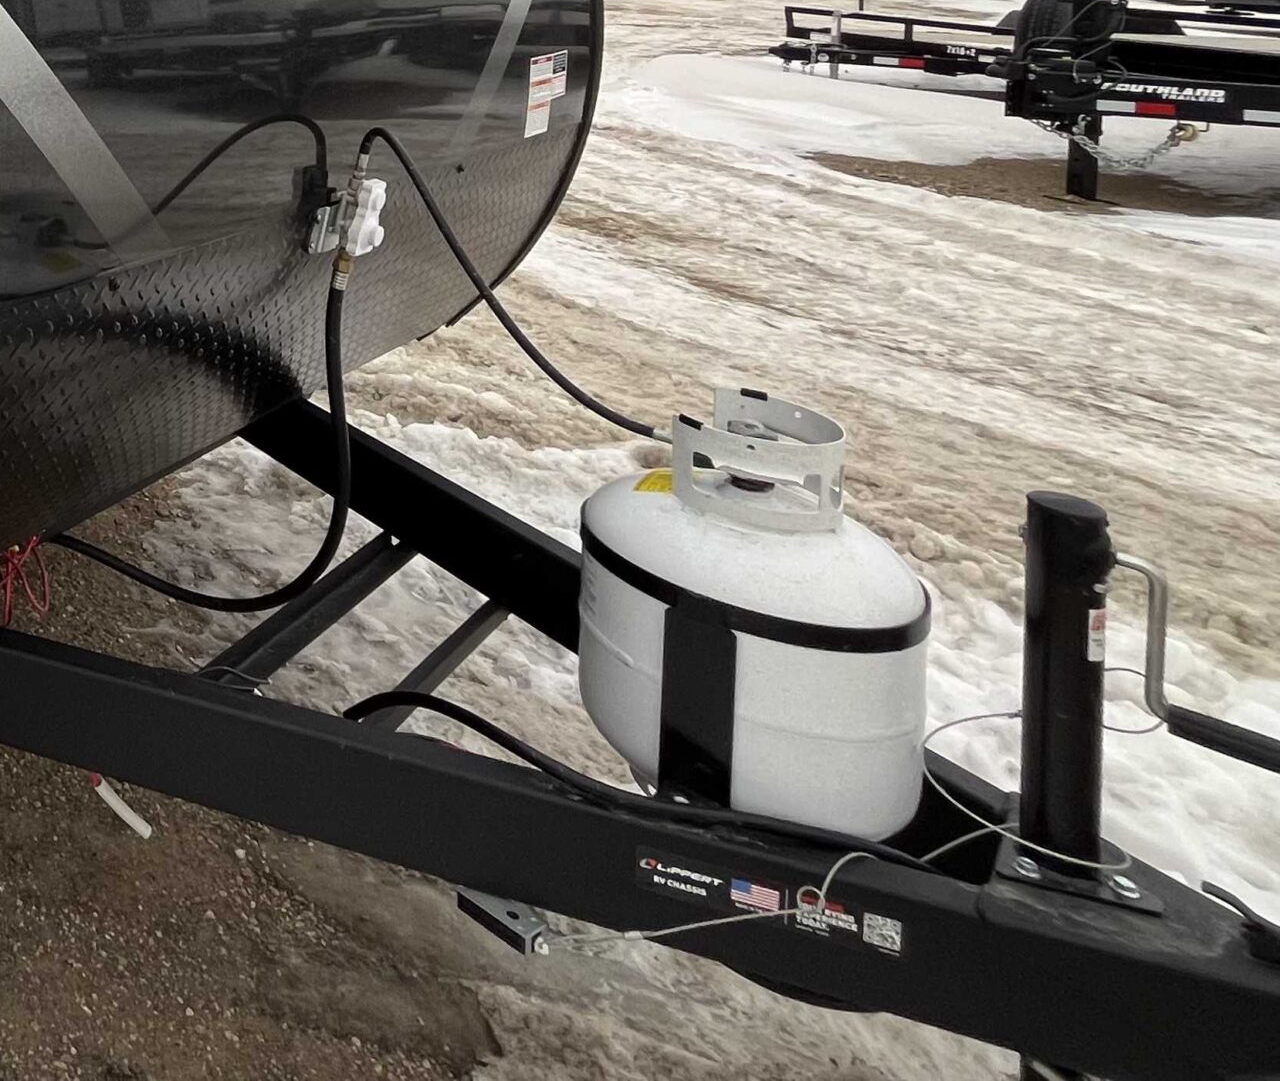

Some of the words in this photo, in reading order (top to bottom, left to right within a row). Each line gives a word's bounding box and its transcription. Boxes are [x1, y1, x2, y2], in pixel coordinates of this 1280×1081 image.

[1101, 82, 1226, 97] SOUTHLAND
[1161, 93, 1225, 104] TRAILERS
[656, 863, 724, 886] LIPPERT
[653, 875, 666, 885] RV
[666, 879, 707, 897] CHASSIS
